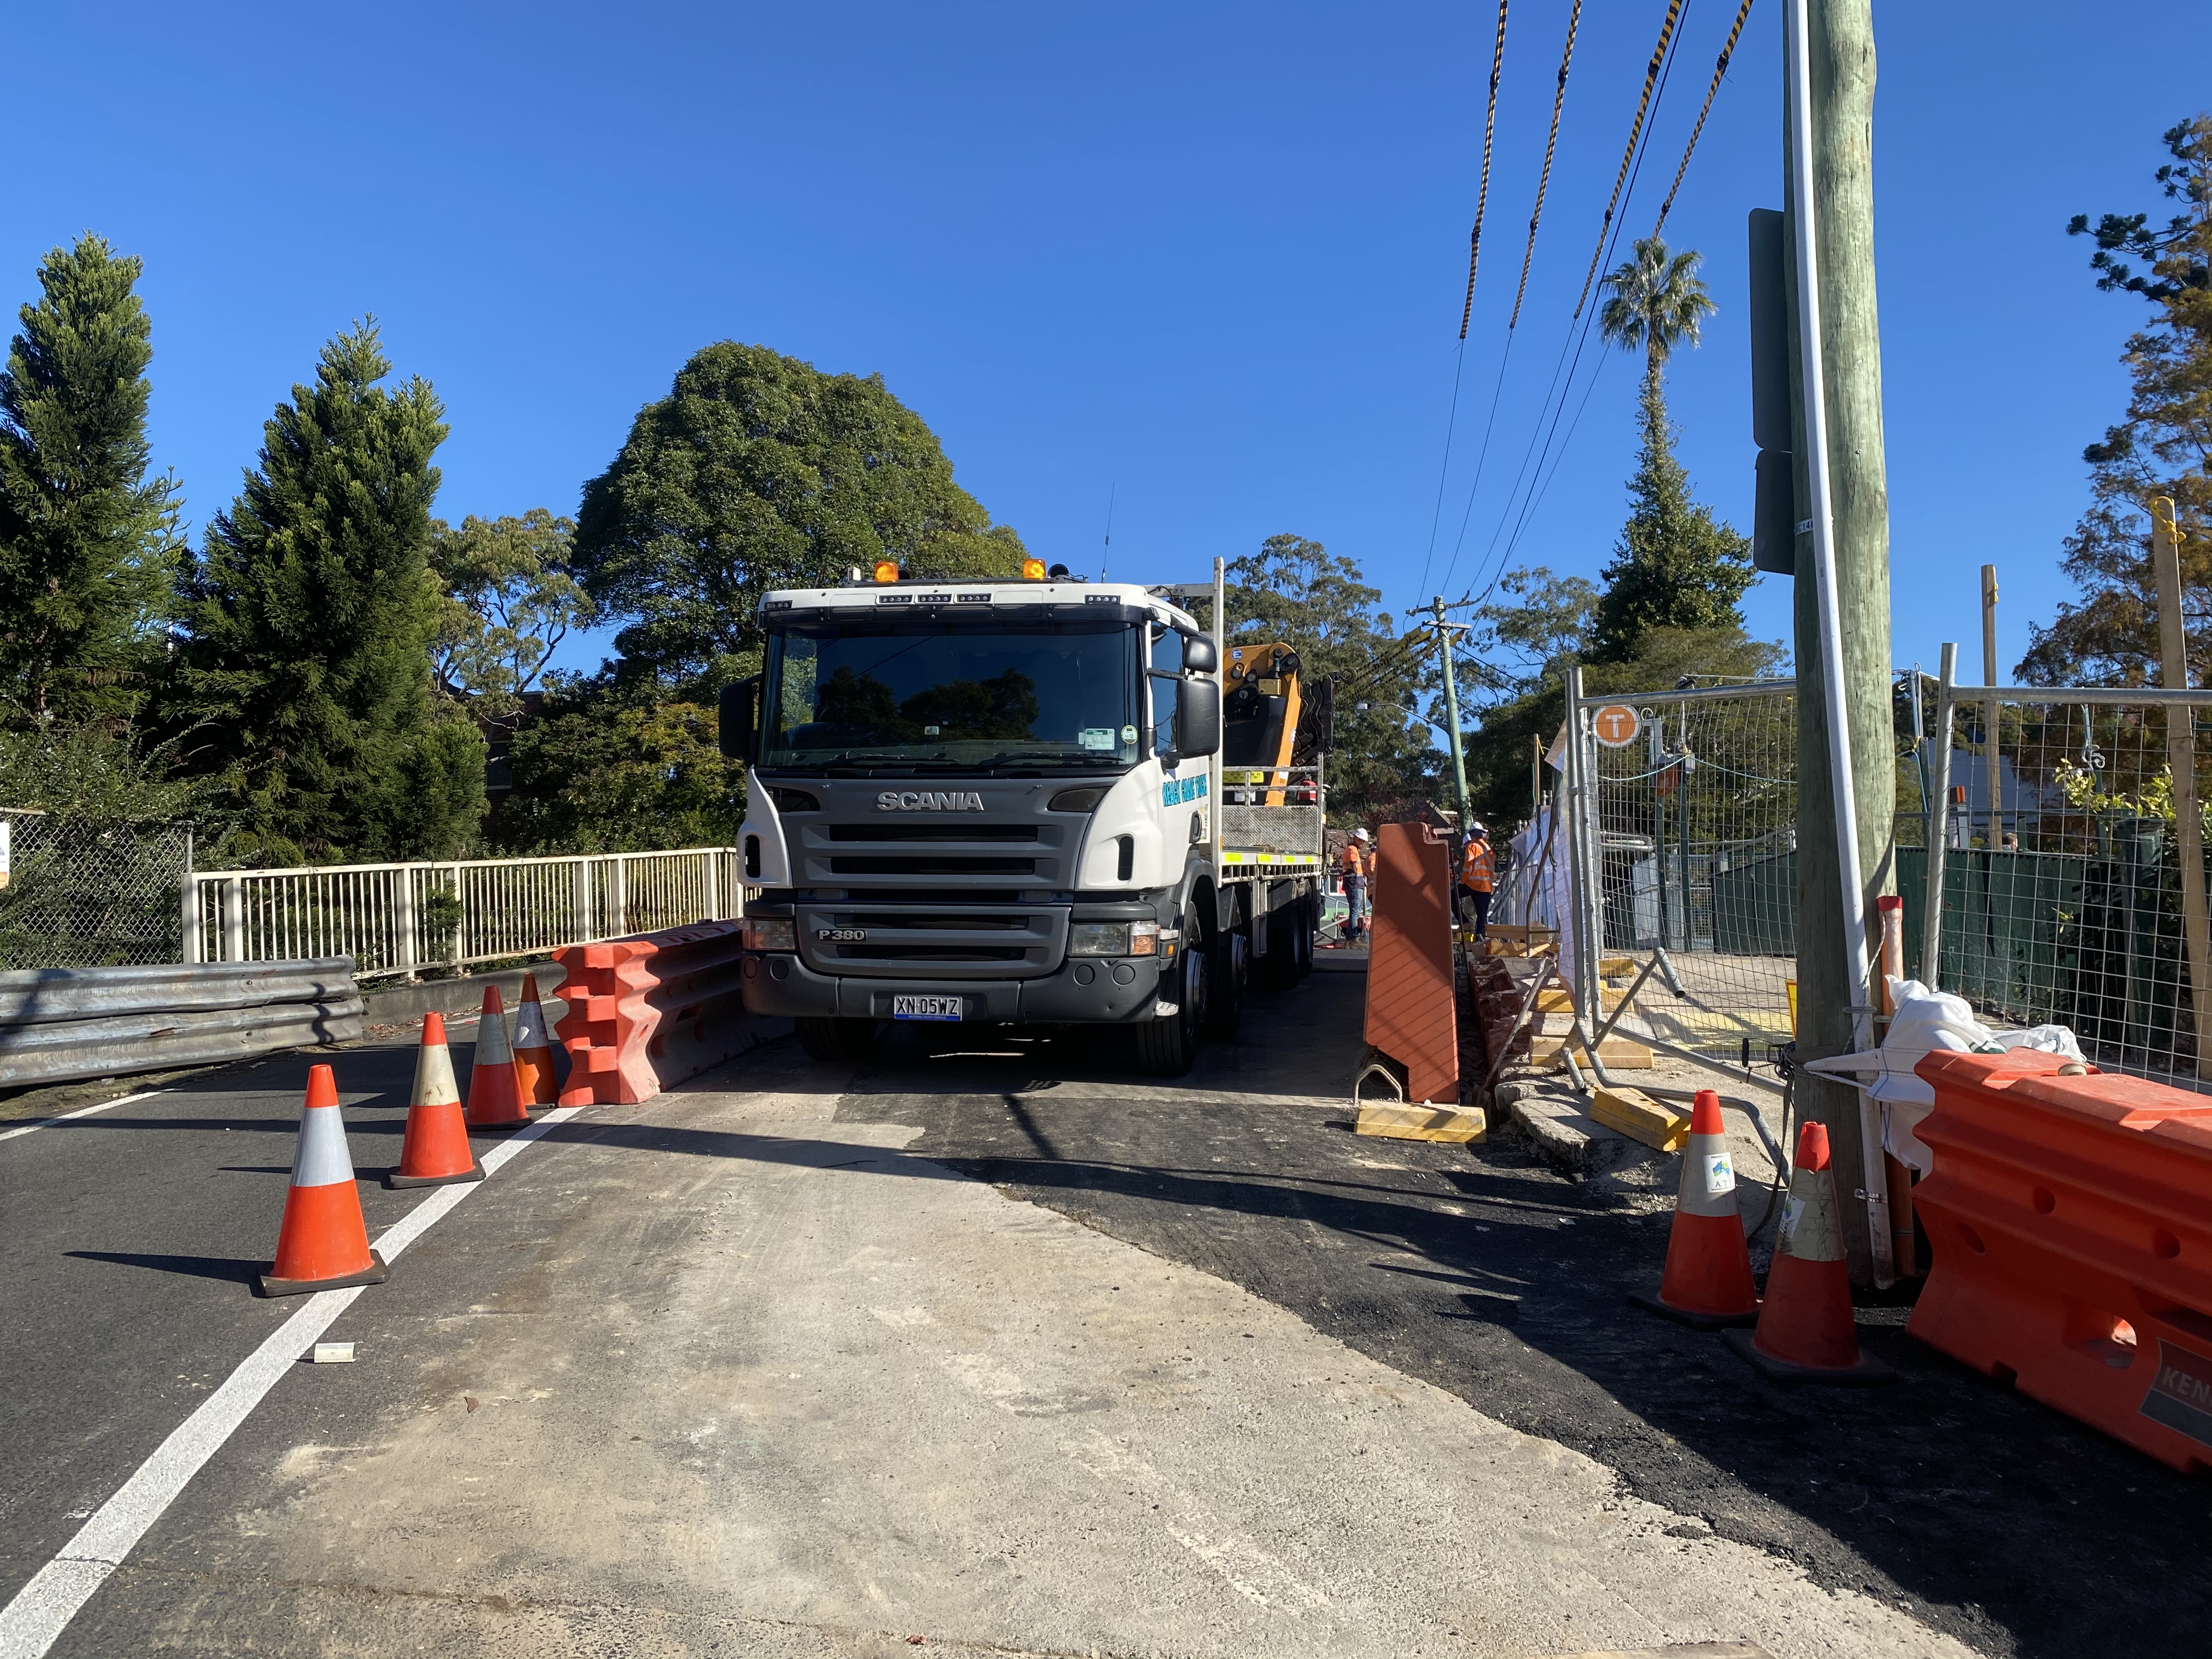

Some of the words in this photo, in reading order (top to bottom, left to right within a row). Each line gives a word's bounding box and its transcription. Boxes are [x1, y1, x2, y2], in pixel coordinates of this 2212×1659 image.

[1606, 714, 1624, 738] T
[877, 792, 984, 811] SCANIA
[819, 930, 830, 940] P
[831, 930, 864, 940] 380
[2162, 1367, 2212, 1407] KEN
